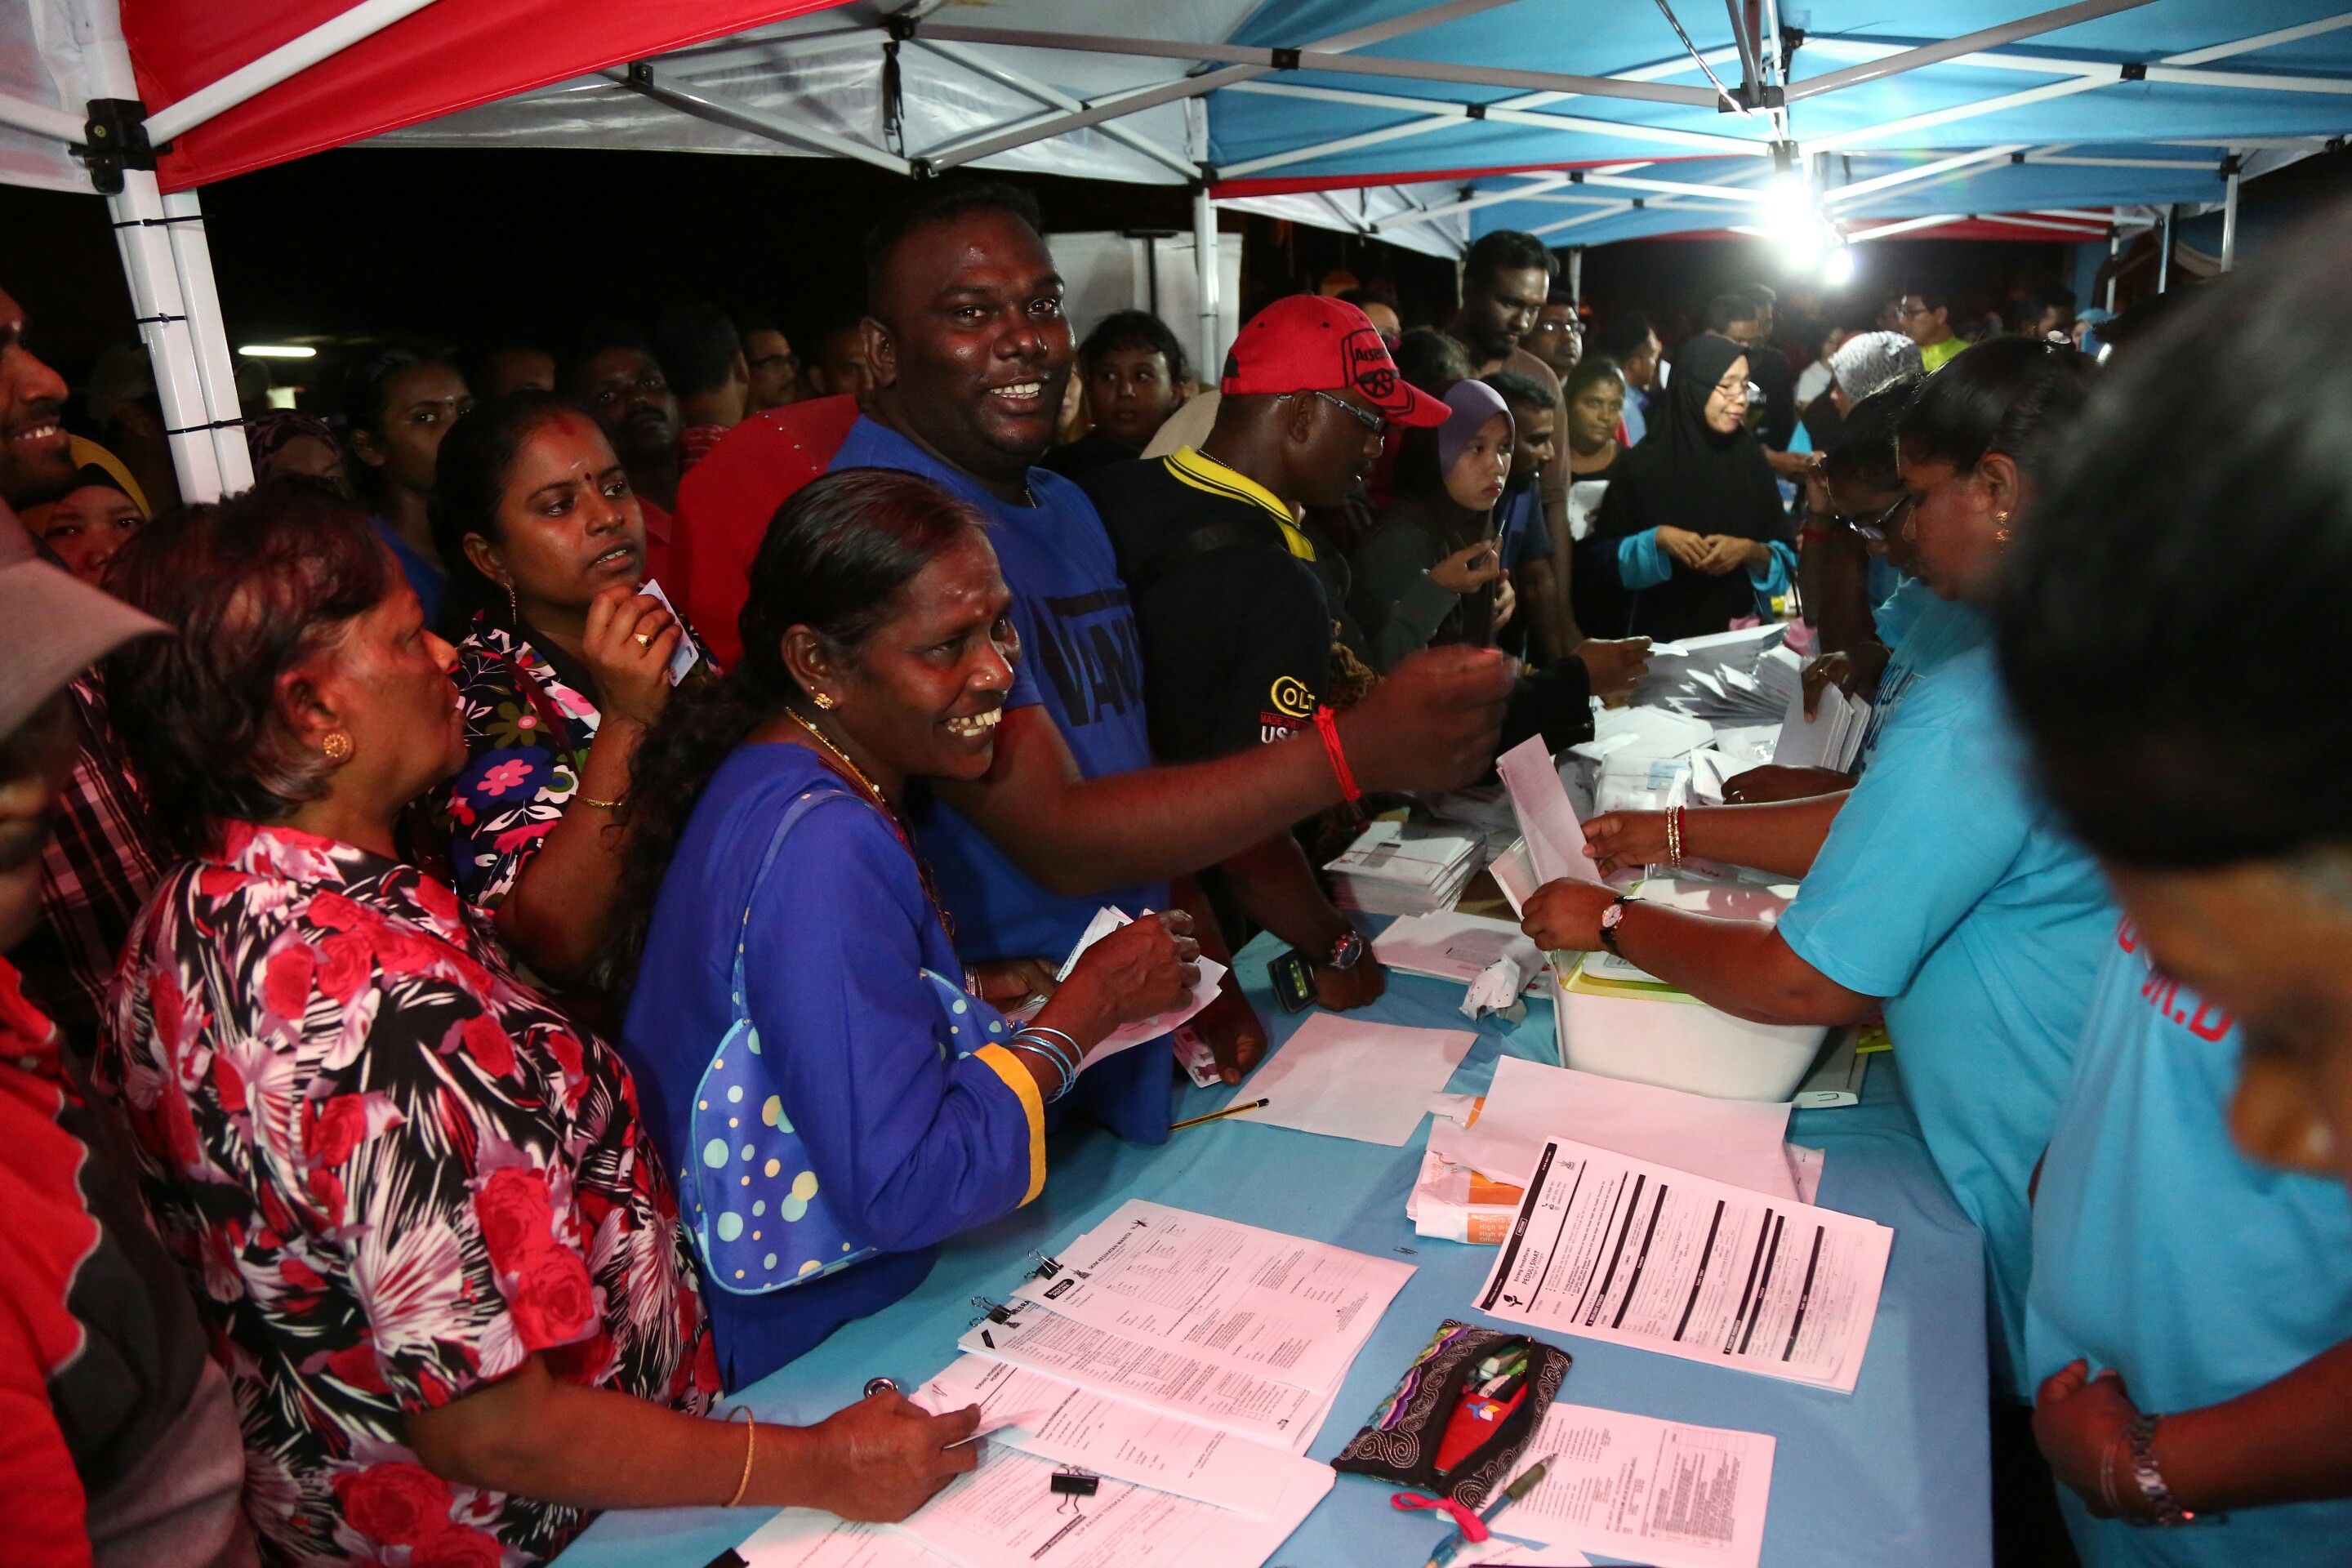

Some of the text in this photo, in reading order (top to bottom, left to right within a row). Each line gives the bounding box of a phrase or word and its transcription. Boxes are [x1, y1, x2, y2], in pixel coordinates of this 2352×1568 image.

[1027, 589, 1145, 728] VAN
[1479, 1216, 1506, 1224] Superb
[1521, 1266, 1534, 1285] PEDULI
[1530, 1250, 1539, 1267] SIHAT
